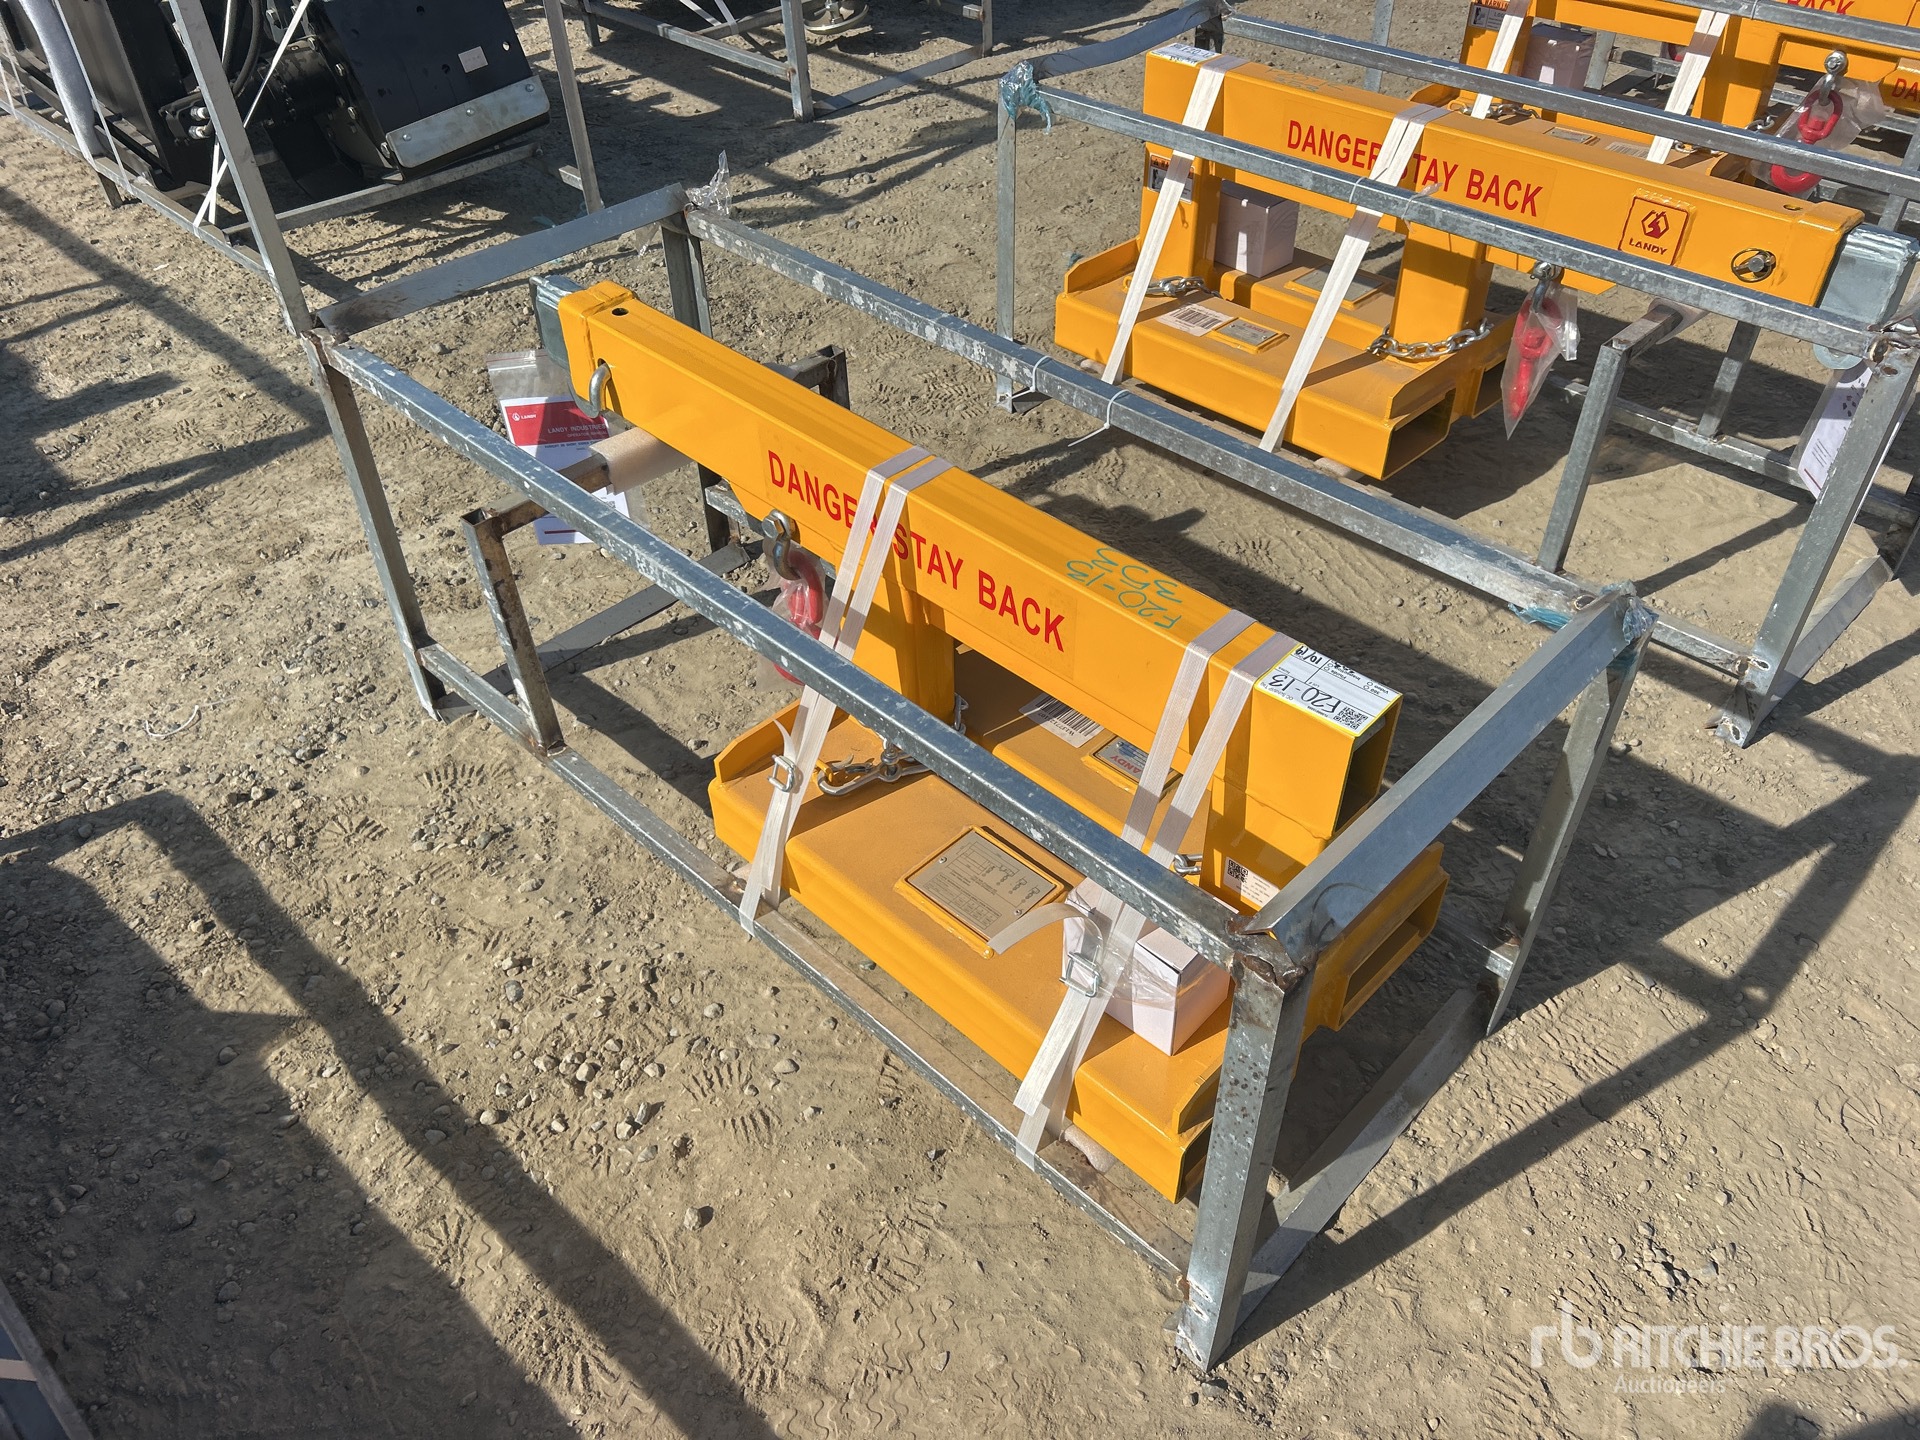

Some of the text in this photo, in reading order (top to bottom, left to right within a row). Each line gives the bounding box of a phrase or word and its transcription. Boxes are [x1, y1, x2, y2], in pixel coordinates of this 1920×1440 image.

[1400, 153, 1459, 192] TAY
[1465, 168, 1543, 218] BACK
[1629, 237, 1668, 255] LANDY
[547, 426, 569, 435] LANDY
[893, 522, 964, 590] STAY
[978, 569, 1065, 652] BACK
[1066, 560, 1183, 629] F20-13
[1091, 548, 1183, 604] 353
[1268, 674, 1341, 713] F20-13
[1110, 755, 1142, 774] ANDY
